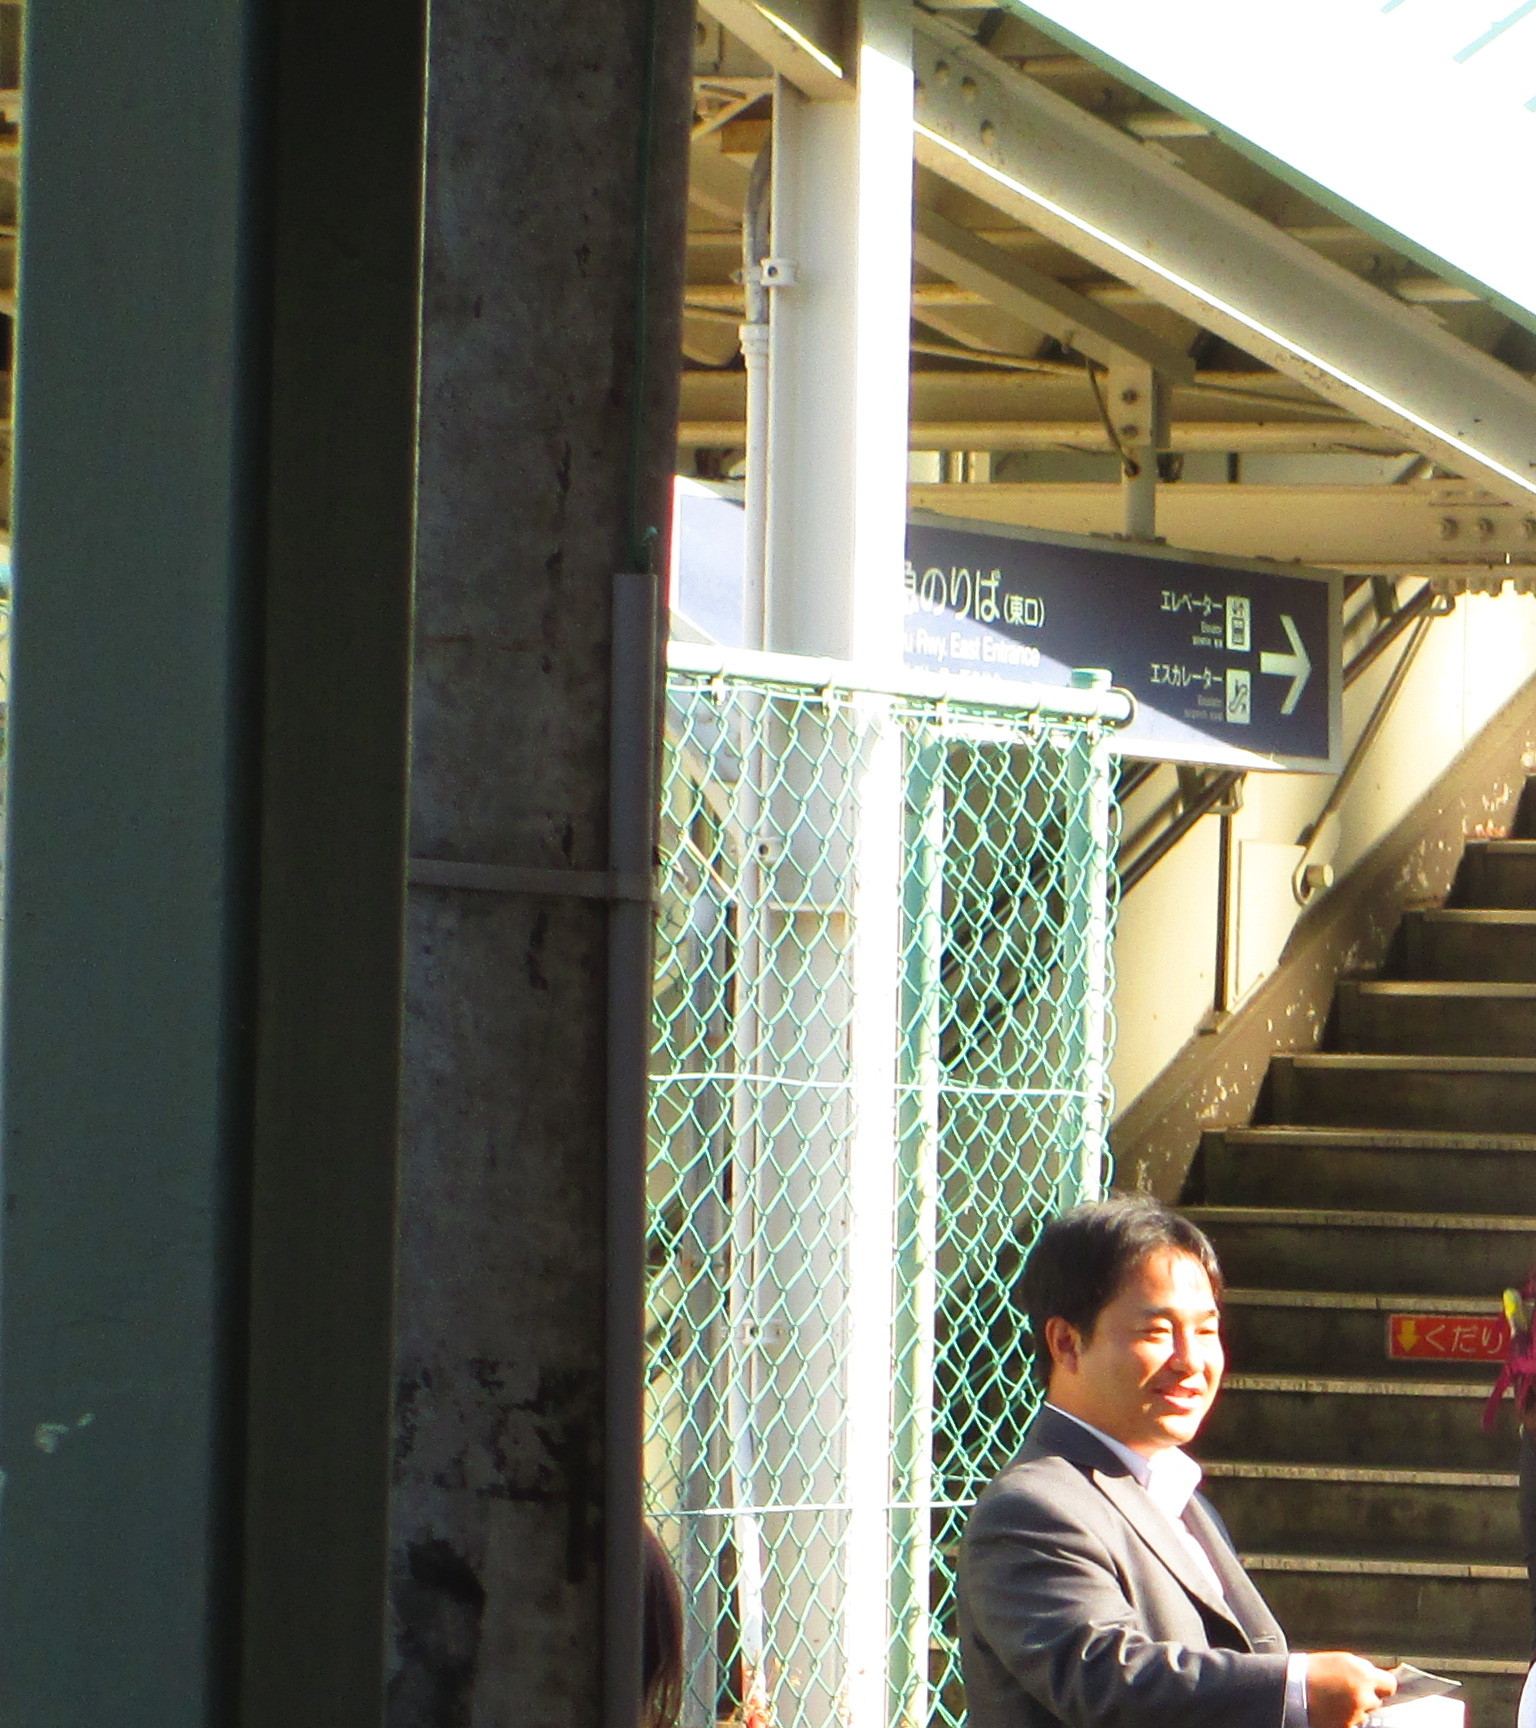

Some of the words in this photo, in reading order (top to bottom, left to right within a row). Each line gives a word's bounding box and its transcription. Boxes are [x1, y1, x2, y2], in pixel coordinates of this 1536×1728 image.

[1160, 590, 1223, 616] エレベーター
[950, 631, 980, 661] East
[983, 636, 1041, 668] Entrance
[1149, 663, 1223, 689] エスカレーター
[1425, 1324, 1503, 1354] くだり
